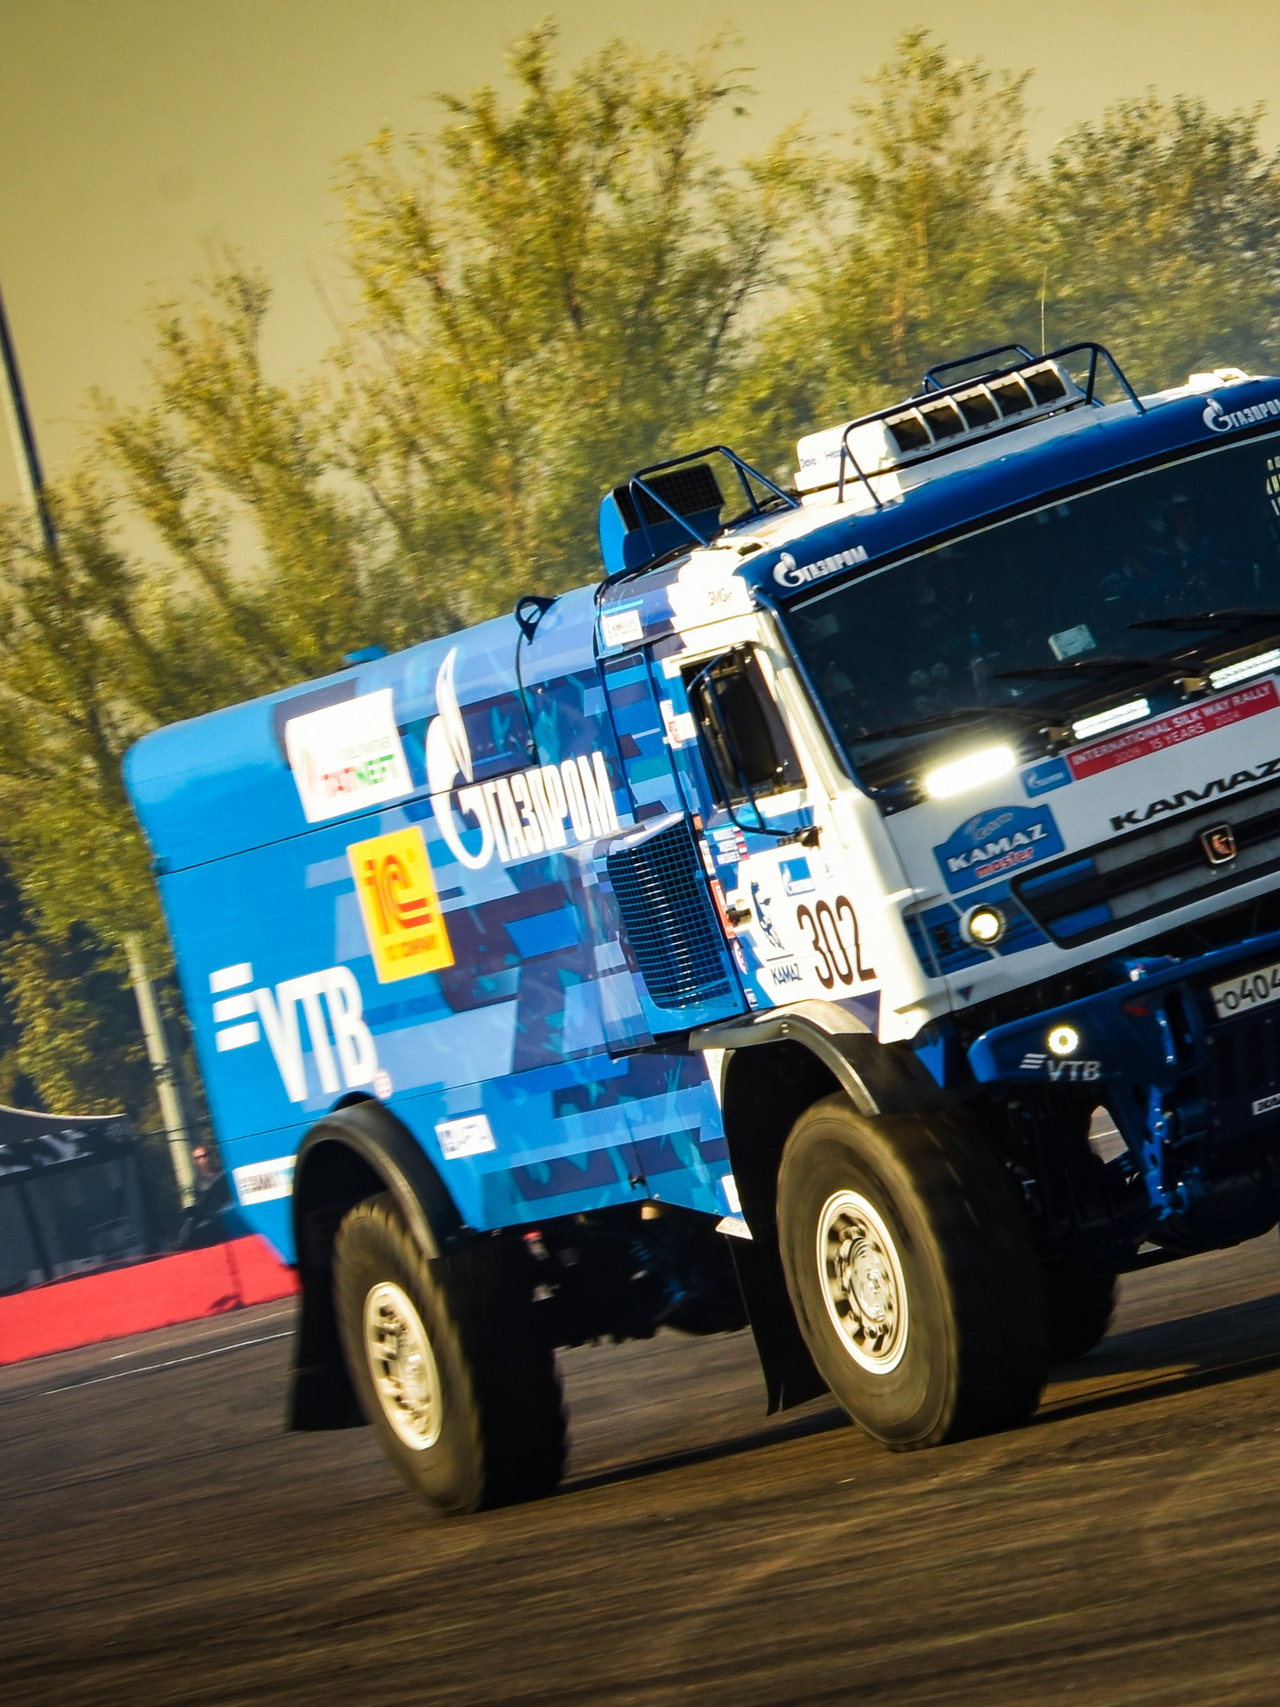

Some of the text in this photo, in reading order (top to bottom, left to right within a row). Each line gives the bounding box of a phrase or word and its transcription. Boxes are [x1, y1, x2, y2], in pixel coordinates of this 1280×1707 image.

[1071, 684, 1272, 765] INTERNATIONAL SILK WAY RALLY
[1163, 722, 1207, 749] YEARS
[946, 823, 1048, 873] KAMAZ
[974, 846, 1034, 879] master
[796, 895, 878, 990] 302
[770, 963, 803, 986] KAMAZ
[250, 965, 378, 1103] VTB
[1047, 1060, 1101, 1081] VTB
